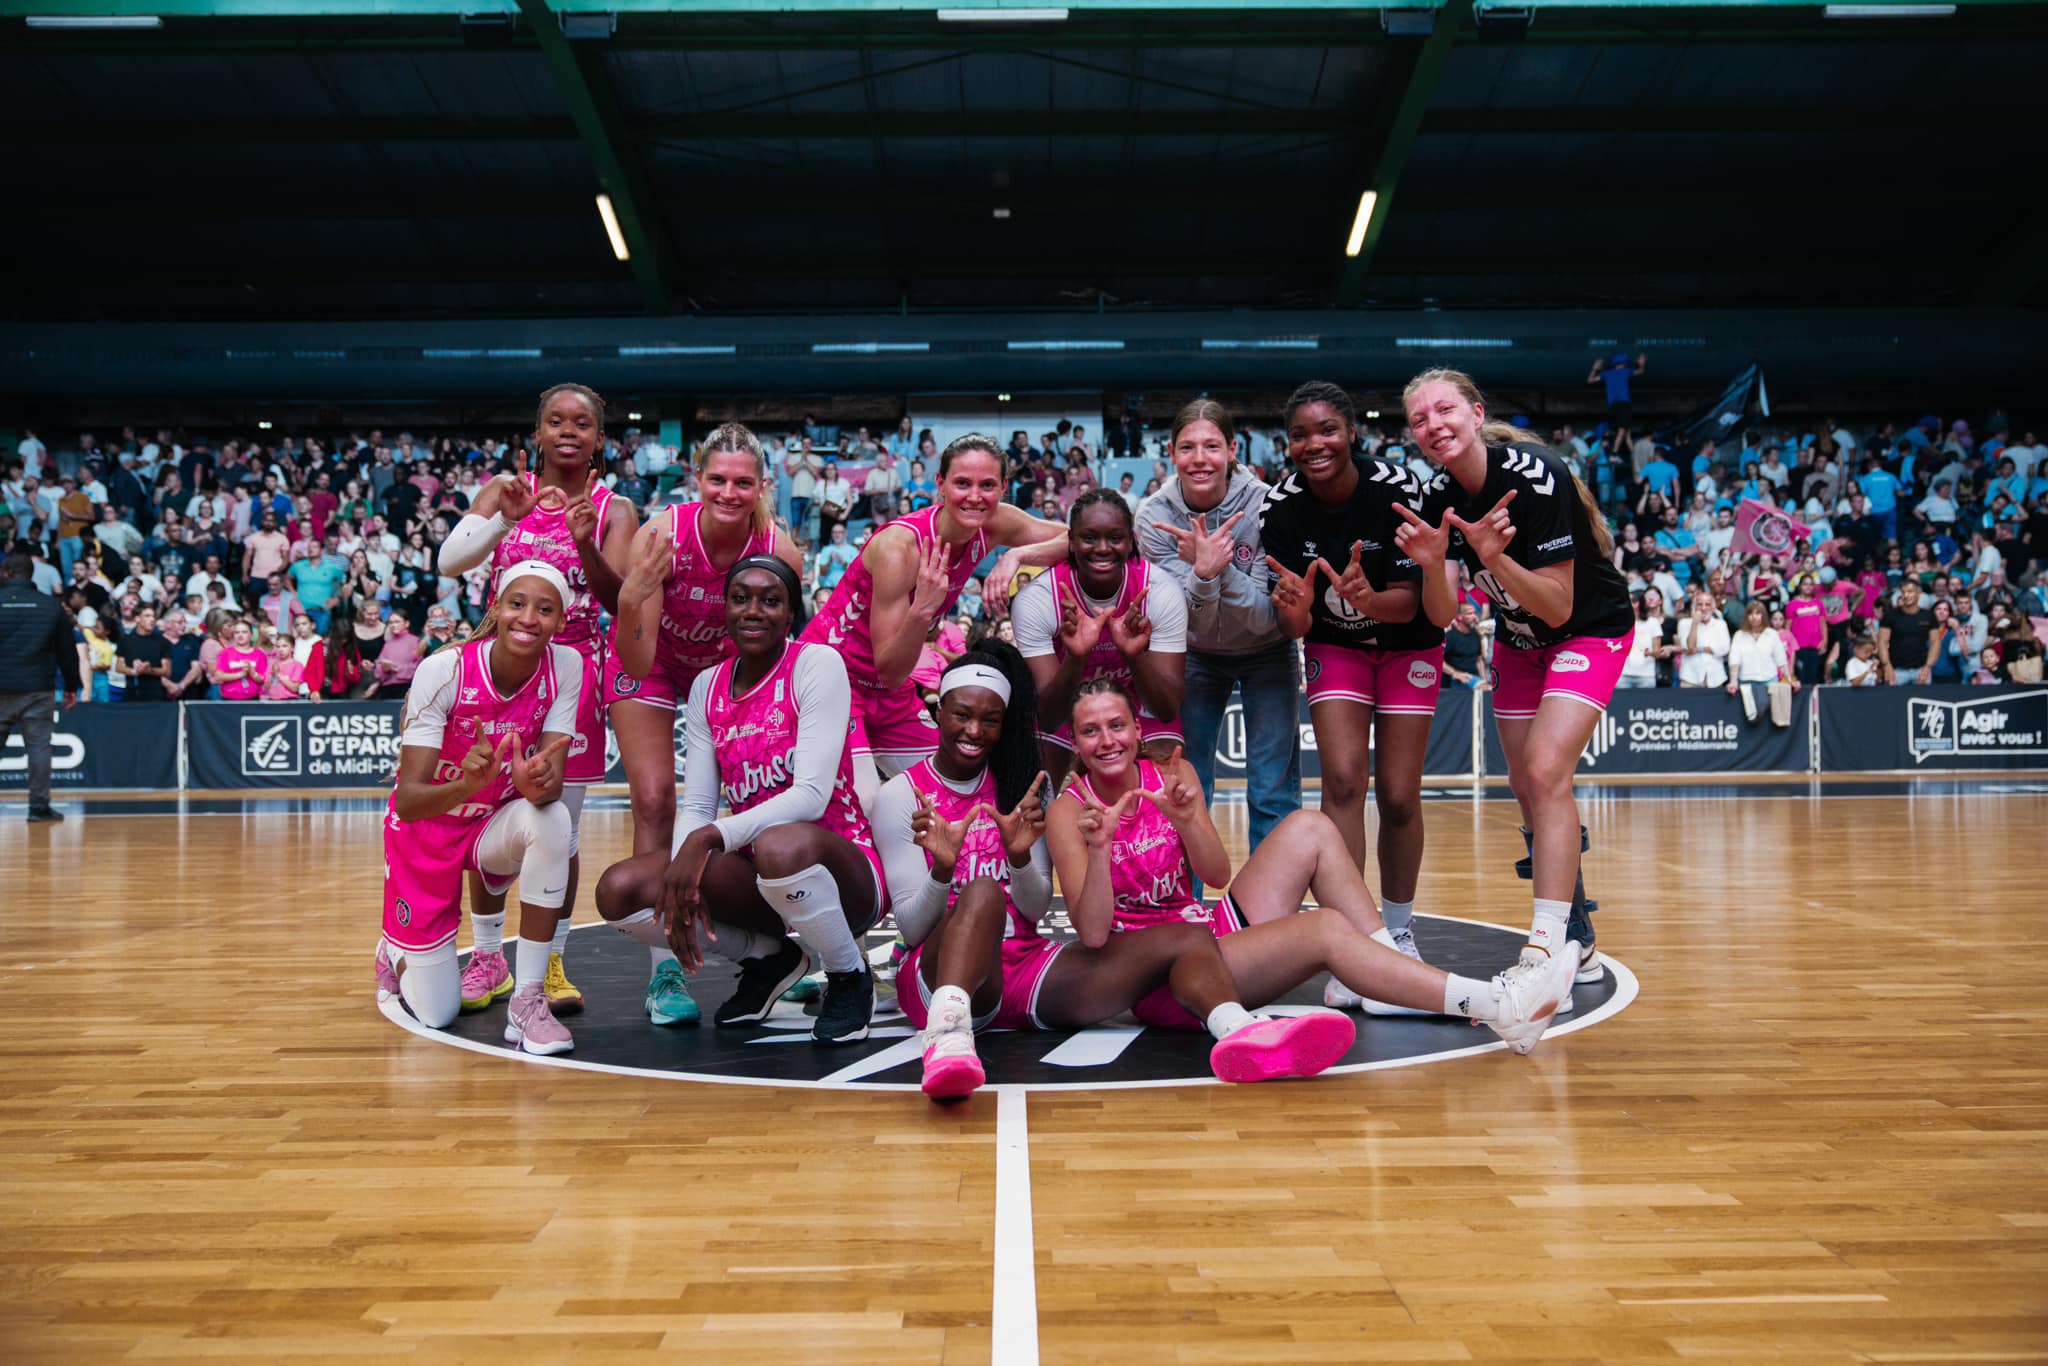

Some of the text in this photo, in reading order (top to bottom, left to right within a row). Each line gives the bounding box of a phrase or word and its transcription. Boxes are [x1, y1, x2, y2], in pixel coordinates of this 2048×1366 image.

[1411, 670, 1436, 680] ICADE
[1629, 707, 1689, 723] La Région
[1960, 709, 2009, 733] Agir
[307, 714, 394, 736] CAISSE
[1629, 720, 1738, 741] Occitanie
[1961, 733, 1996, 746] avec
[1998, 733, 2034, 746] vous
[2035, 730, 2042, 745] !
[308, 757, 333, 775] de
